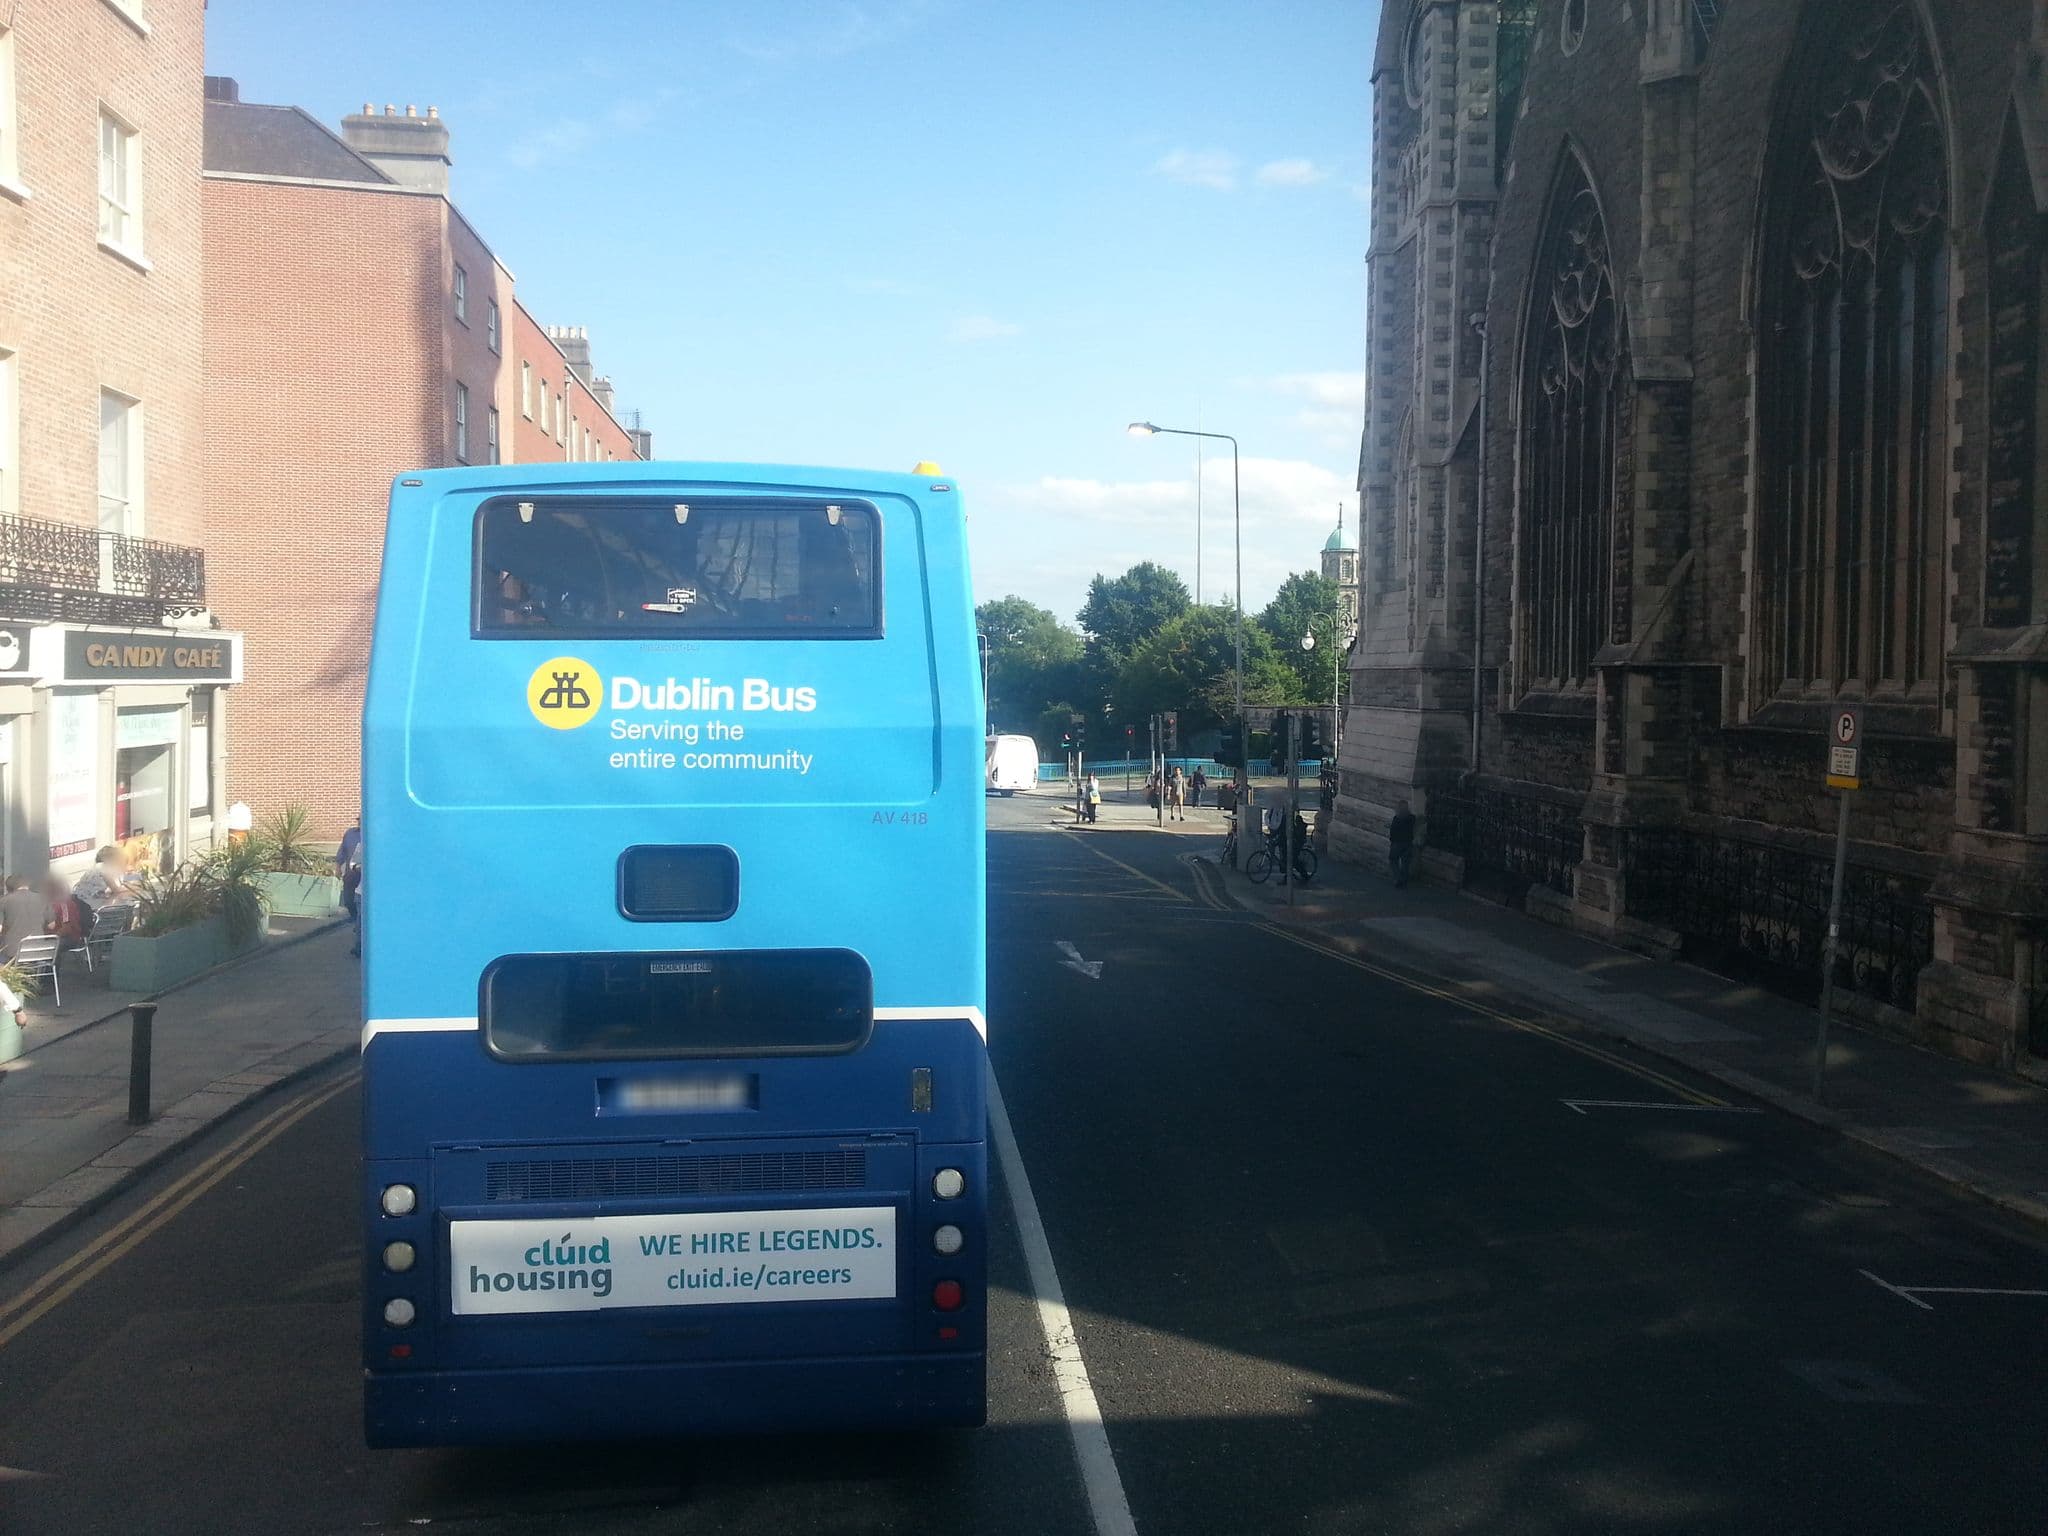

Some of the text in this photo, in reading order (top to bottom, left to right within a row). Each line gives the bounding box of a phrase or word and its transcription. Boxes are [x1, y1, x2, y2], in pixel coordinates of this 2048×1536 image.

[86, 642, 223, 669] CANDY CAFÉ
[611, 677, 817, 712] Dublin Bus
[610, 718, 744, 745] Serving the
[609, 744, 813, 775] entire community
[872, 811, 928, 825] AV 418
[524, 1227, 883, 1267] clúid WE HIRE LEGENDS.
[469, 1263, 852, 1298] housing cluid.ie/careers
